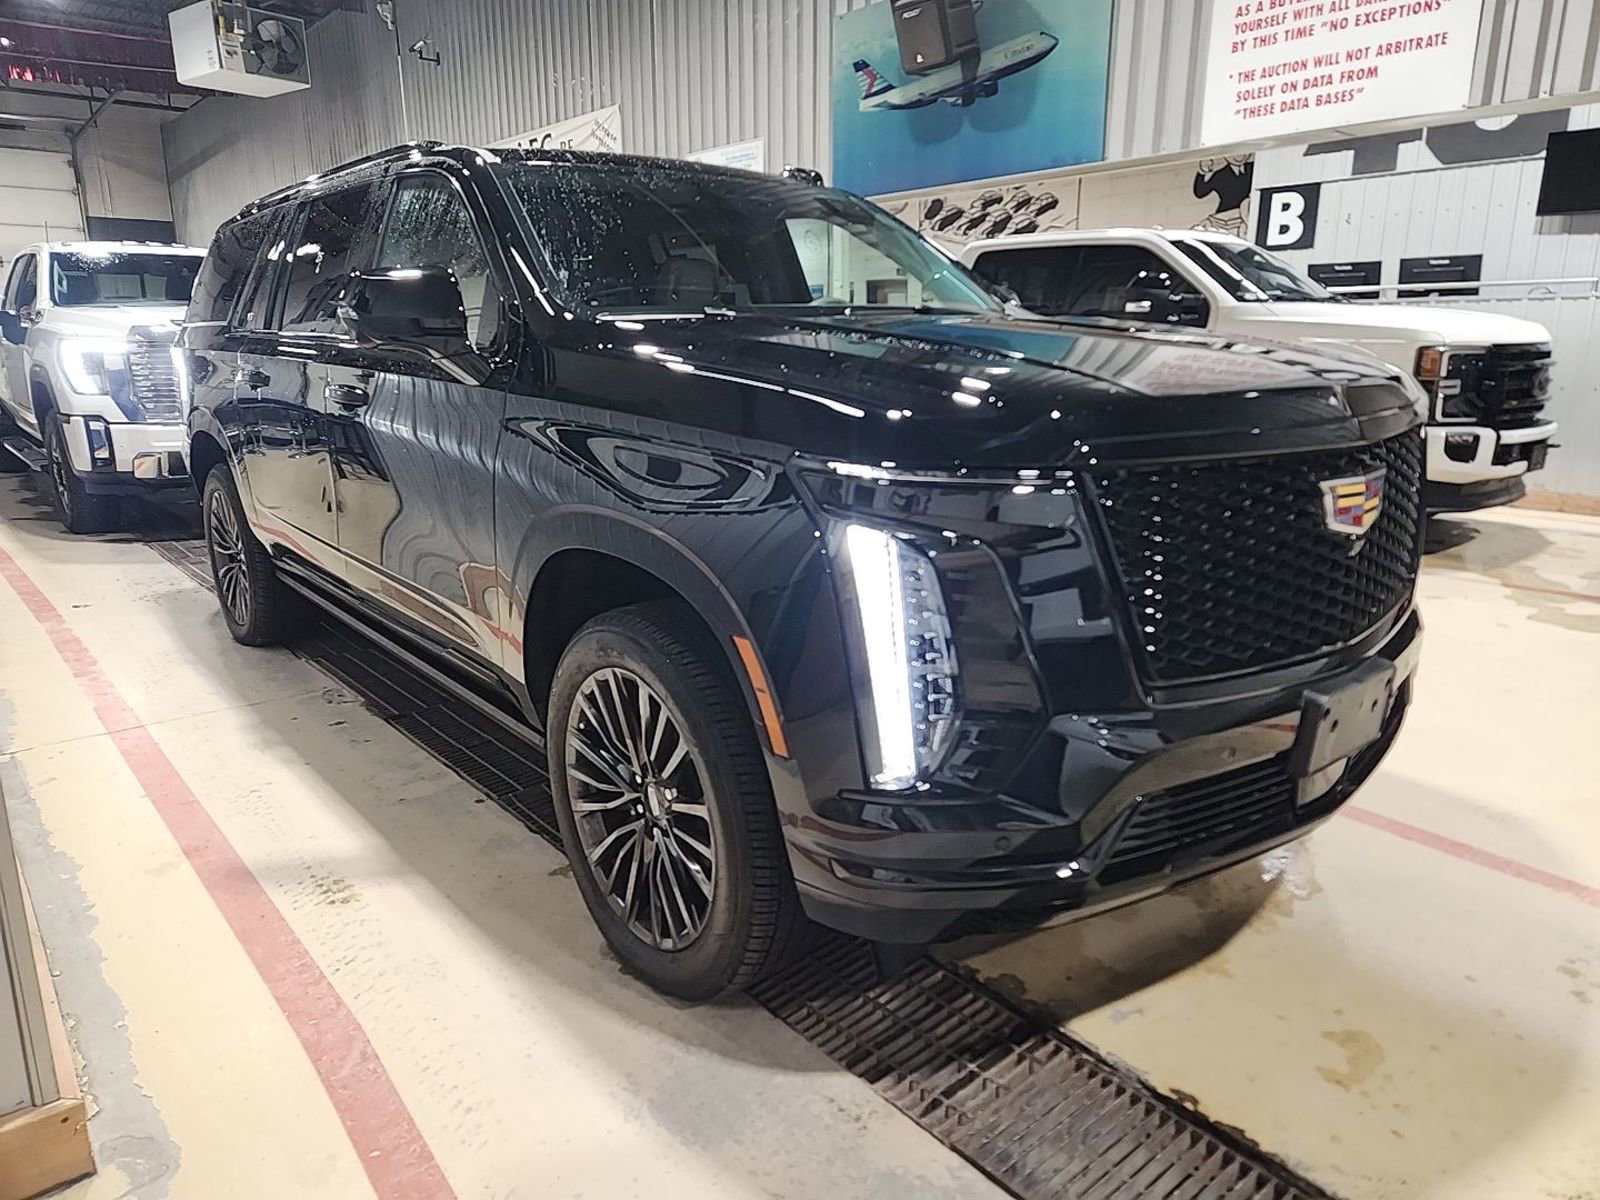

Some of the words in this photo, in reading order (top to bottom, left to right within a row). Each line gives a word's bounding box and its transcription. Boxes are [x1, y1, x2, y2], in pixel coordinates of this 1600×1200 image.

[1234, 12, 1288, 35] YOURSELF
[1293, 4, 1324, 21] WITH
[1329, 0, 1350, 13] ALL
[1235, 4, 1250, 18] AS
[1255, 1, 1263, 14] A
[1231, 39, 1247, 54] BY
[1253, 32, 1279, 49] THIS
[1284, 24, 1316, 42] TIME
[1321, 17, 1349, 32] "NO
[1237, 69, 1256, 84] THE
[1260, 58, 1308, 79] AUCTION
[1313, 52, 1340, 68] WILL
[1345, 46, 1371, 63] NOT
[1376, 32, 1449, 57] ARBITRATE
[1236, 84, 1276, 103] SOLELY
[1281, 80, 1299, 94] ON
[1303, 74, 1334, 90] DATA
[1339, 66, 1379, 84] FROM
[1234, 103, 1276, 120] "THESE
[1280, 97, 1310, 113] DATA
[1315, 87, 1365, 107] BASES"
[1266, 190, 1306, 246] B
